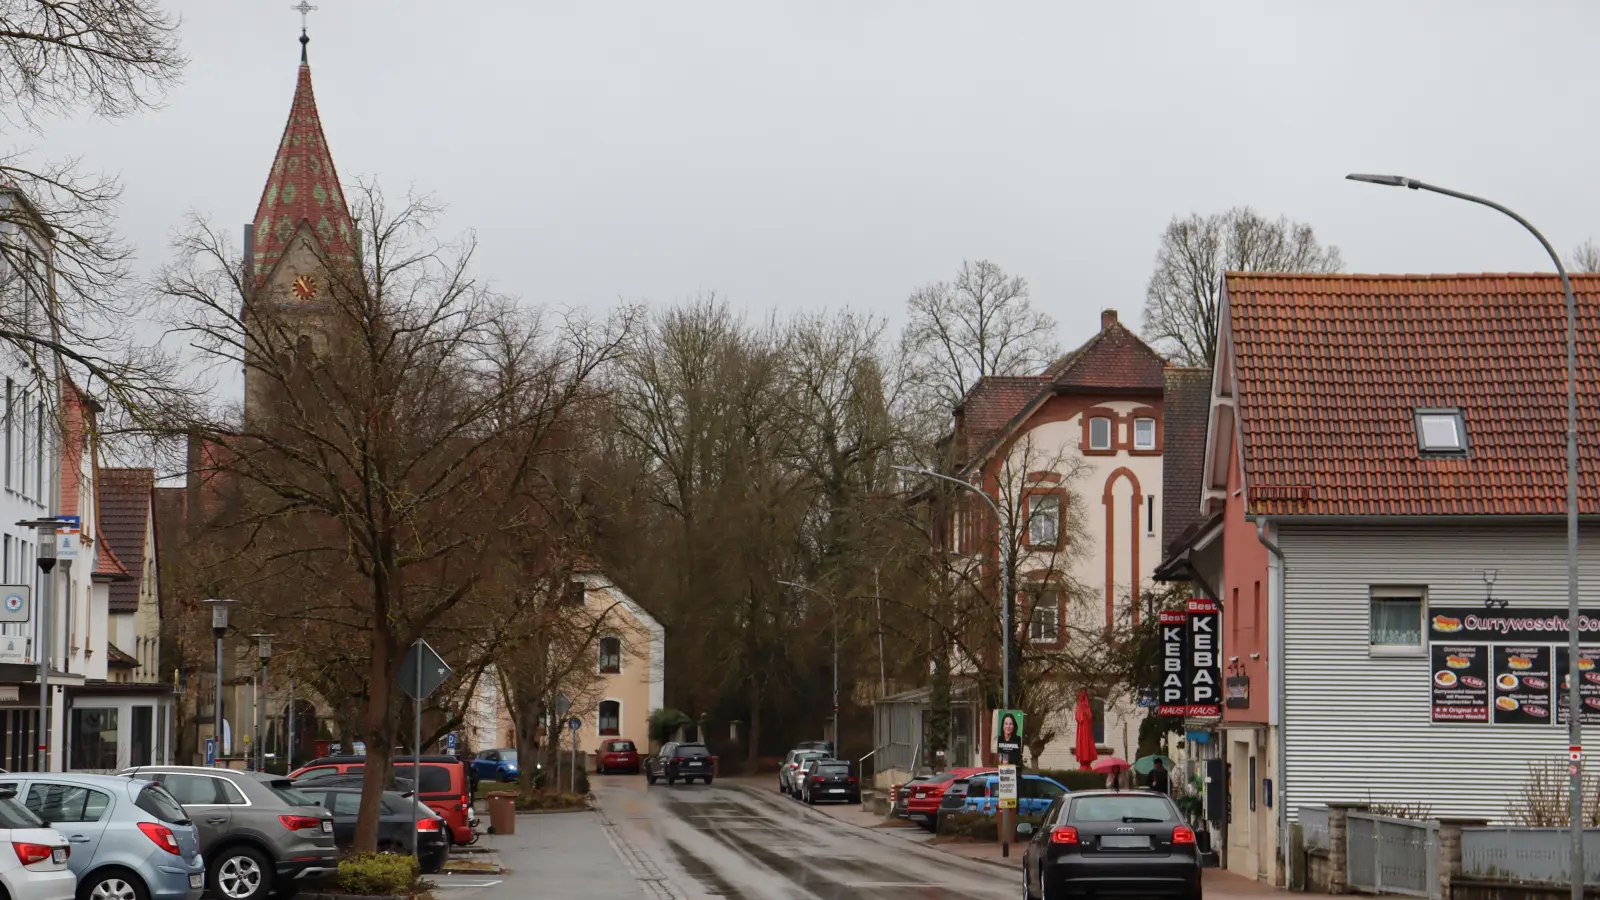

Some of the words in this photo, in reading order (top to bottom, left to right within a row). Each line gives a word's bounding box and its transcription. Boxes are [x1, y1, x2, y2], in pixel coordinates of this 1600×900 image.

[1188, 601, 1218, 610] Best
[1160, 613, 1185, 621] Best
[1576, 615, 1600, 632] Co
[1163, 627, 1182, 702] KEBAP
[1192, 616, 1213, 702] KEBAP
[1160, 706, 1184, 714] HAUS
[1189, 706, 1216, 714] HAUS
[207, 742, 213, 762] P
